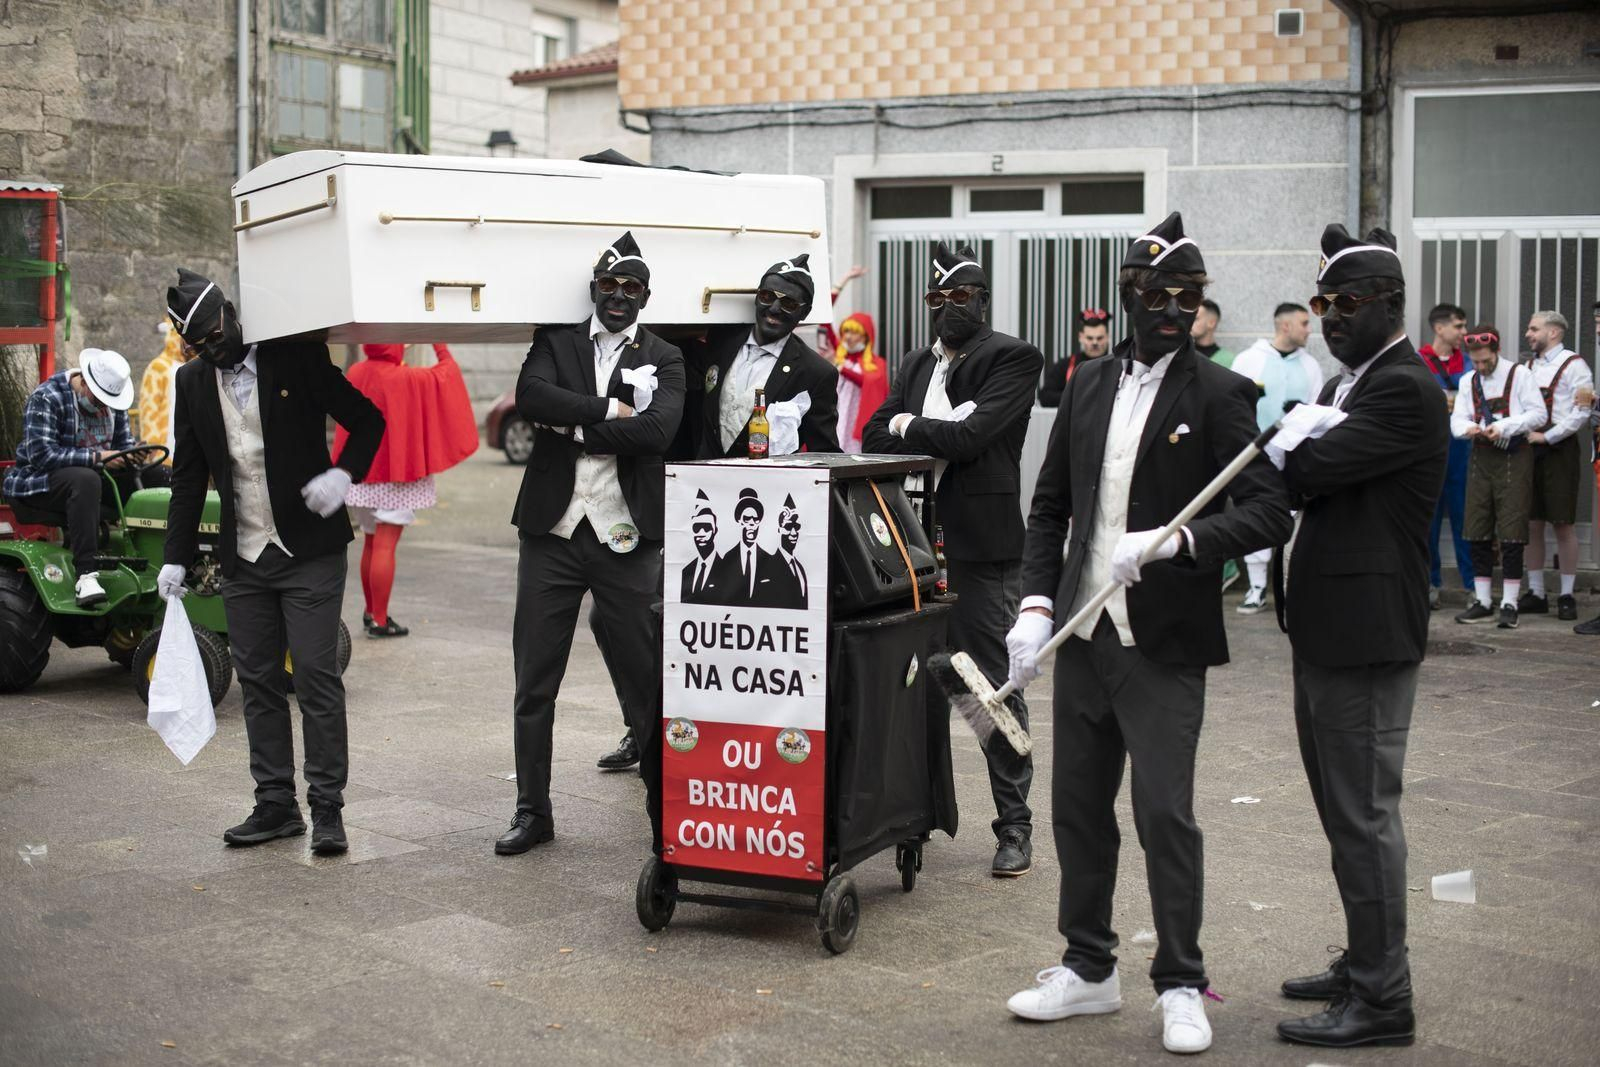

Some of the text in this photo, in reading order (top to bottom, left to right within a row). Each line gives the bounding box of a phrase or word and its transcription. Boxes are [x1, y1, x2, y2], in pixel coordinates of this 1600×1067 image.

[992, 154, 1004, 172] 2
[139, 519, 220, 532] 140 EER
[680, 613, 809, 654] QUÉDATE
[685, 662, 805, 697] NA CASA
[722, 740, 762, 769] OU
[688, 779, 797, 815] BRINCA
[679, 820, 805, 858] CON NÓS
